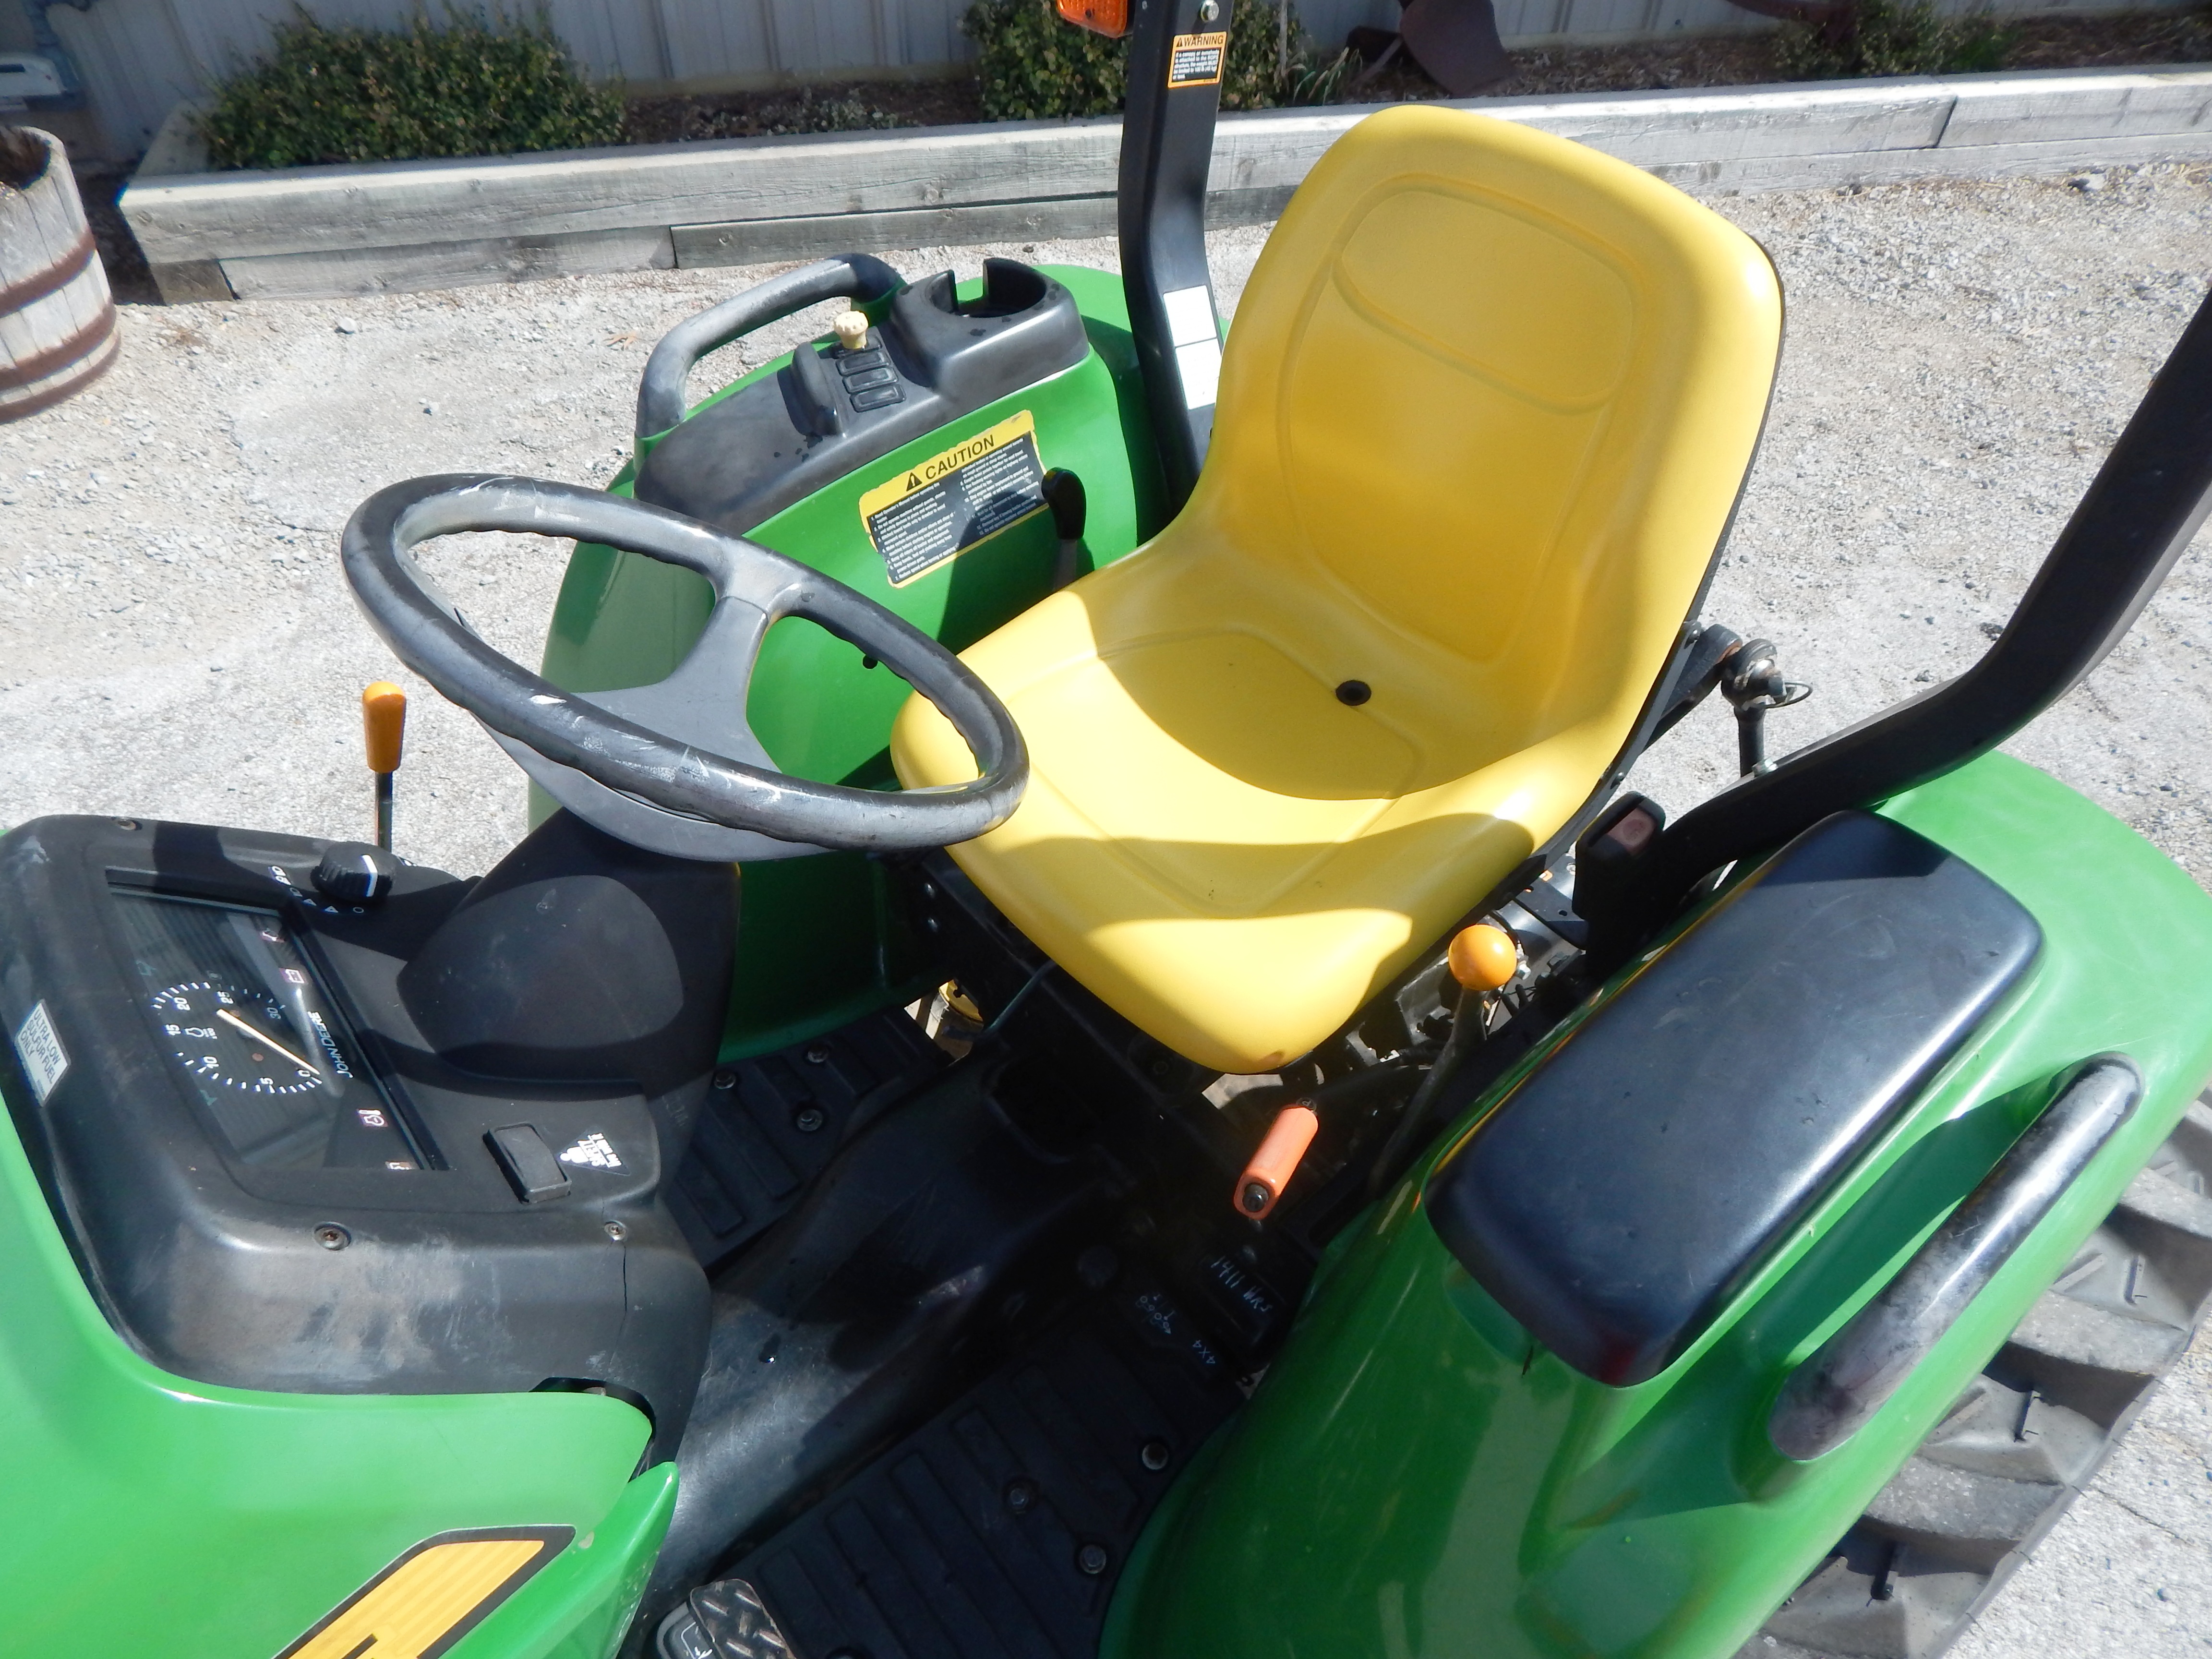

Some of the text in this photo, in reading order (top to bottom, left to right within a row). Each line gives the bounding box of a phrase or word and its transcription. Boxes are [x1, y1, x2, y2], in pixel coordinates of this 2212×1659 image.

[1184, 35, 1224, 47] WARNING
[926, 434, 995, 480] CAUTION
[173, 997, 191, 1011] 20
[216, 991, 234, 1004] 25
[267, 1007, 281, 1020] 30
[165, 1024, 181, 1035] 15
[21, 1030, 35, 1057] ONLY
[34, 1009, 61, 1066] ULTRA LOW
[307, 1011, 354, 1079] JOHN DEERE
[27, 1020, 46, 1059] SULFUR
[42, 1055, 55, 1084] FUEL
[203, 1056, 219, 1069] 10
[298, 1069, 311, 1077] 0
[260, 1077, 274, 1085] 5
[1211, 1256, 1246, 1288] 1411
